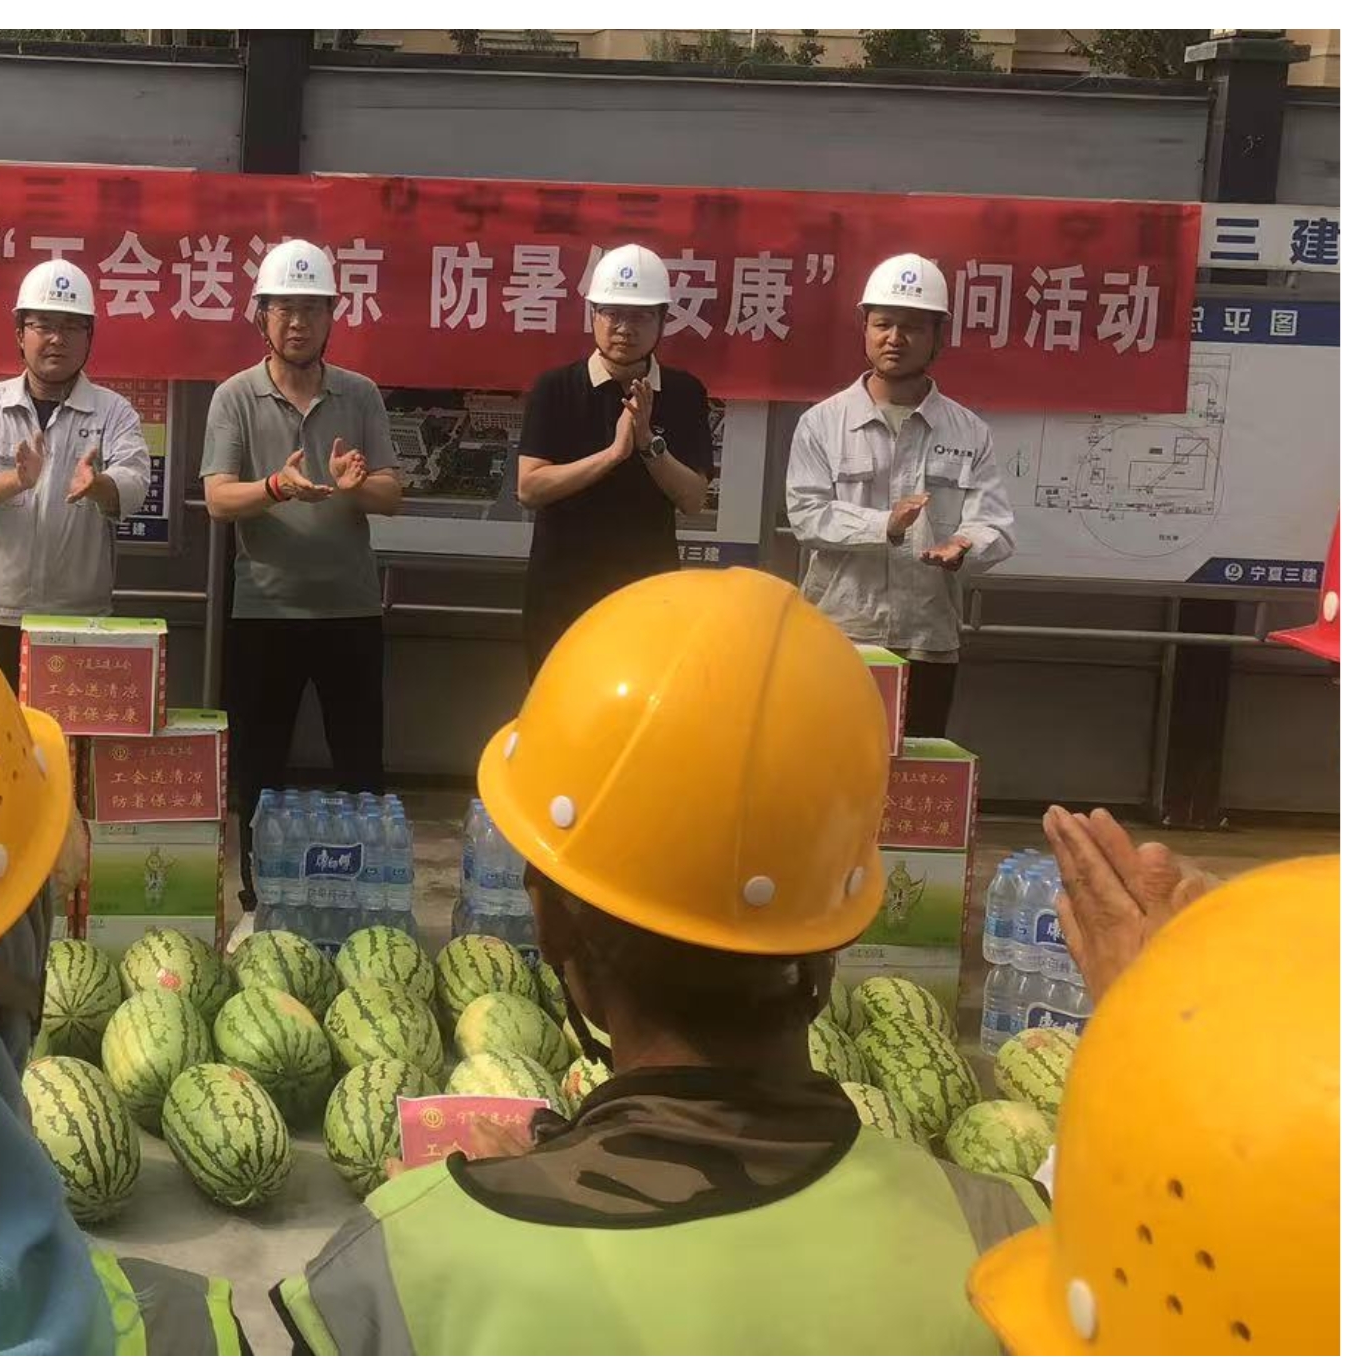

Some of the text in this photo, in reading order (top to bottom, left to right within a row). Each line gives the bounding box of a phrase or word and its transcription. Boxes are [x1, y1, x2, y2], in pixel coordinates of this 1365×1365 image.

[1250, 567, 1317, 583] 宁夏三建
[45, 682, 139, 699] 工会送清凉
[110, 768, 204, 785] 工会送清凉
